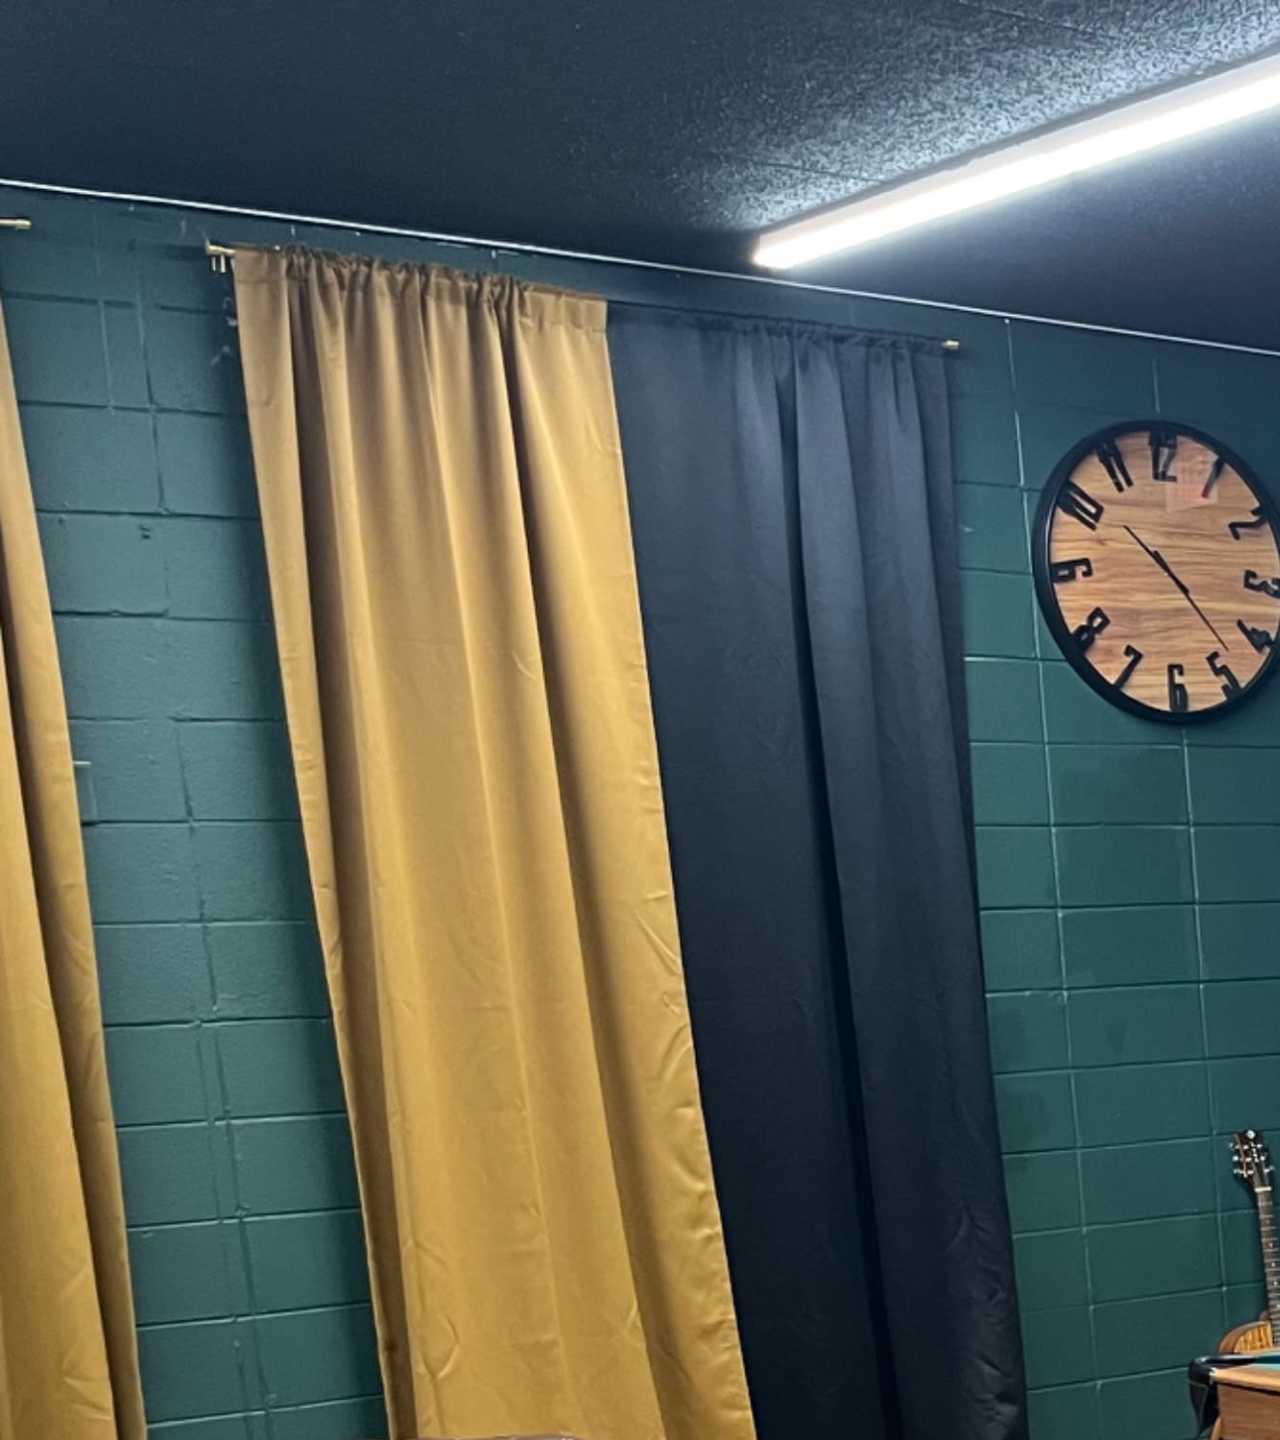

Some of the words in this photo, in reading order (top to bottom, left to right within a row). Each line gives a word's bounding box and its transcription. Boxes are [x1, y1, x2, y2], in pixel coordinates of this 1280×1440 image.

[1149, 430, 1177, 482] 12
[1228, 506, 1268, 540] 2
[1072, 607, 1110, 653] 8
[1237, 619, 1276, 654] 4
[1114, 645, 1143, 690] 7
[1167, 664, 1188, 713] 6
[1206, 651, 1241, 700] 5
